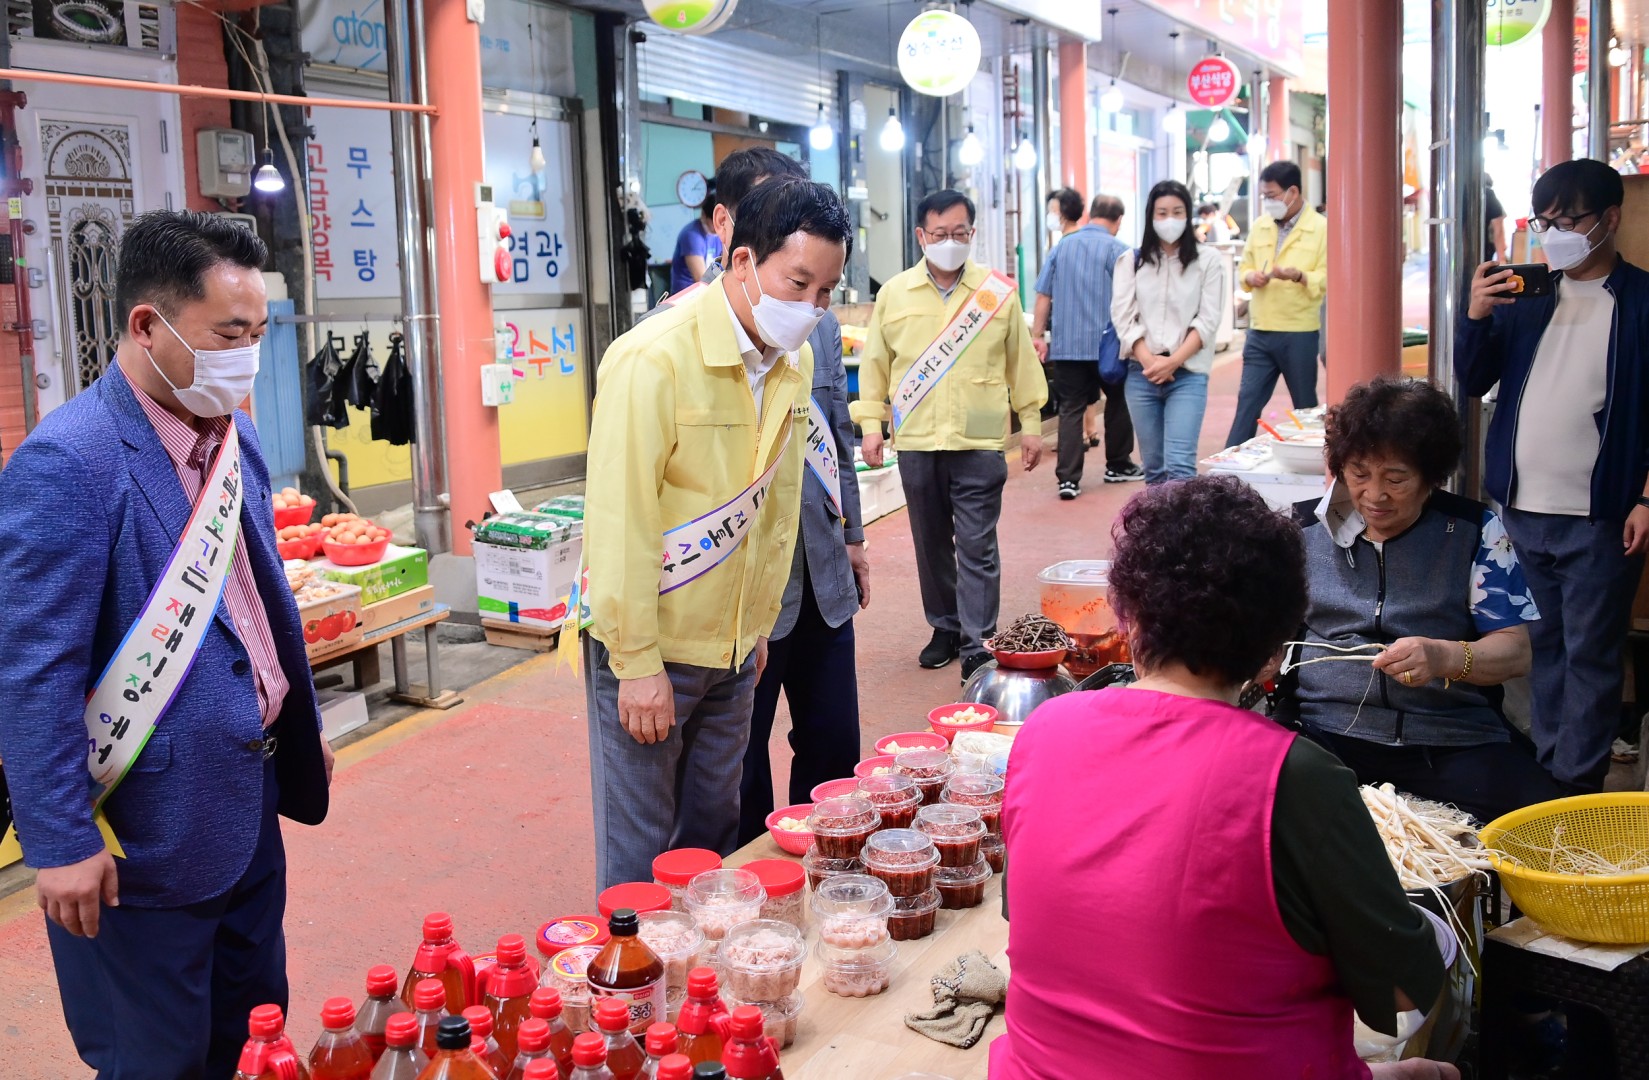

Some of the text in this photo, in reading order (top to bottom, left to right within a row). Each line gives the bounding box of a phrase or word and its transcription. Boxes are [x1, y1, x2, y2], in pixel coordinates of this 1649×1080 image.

[1191, 70, 1231, 90] 부산식당
[346, 146, 377, 282] 무스탕
[505, 321, 576, 378] 옷수선
[902, 355, 942, 401] 전통시장
[629, 1002, 652, 1020] 초장
